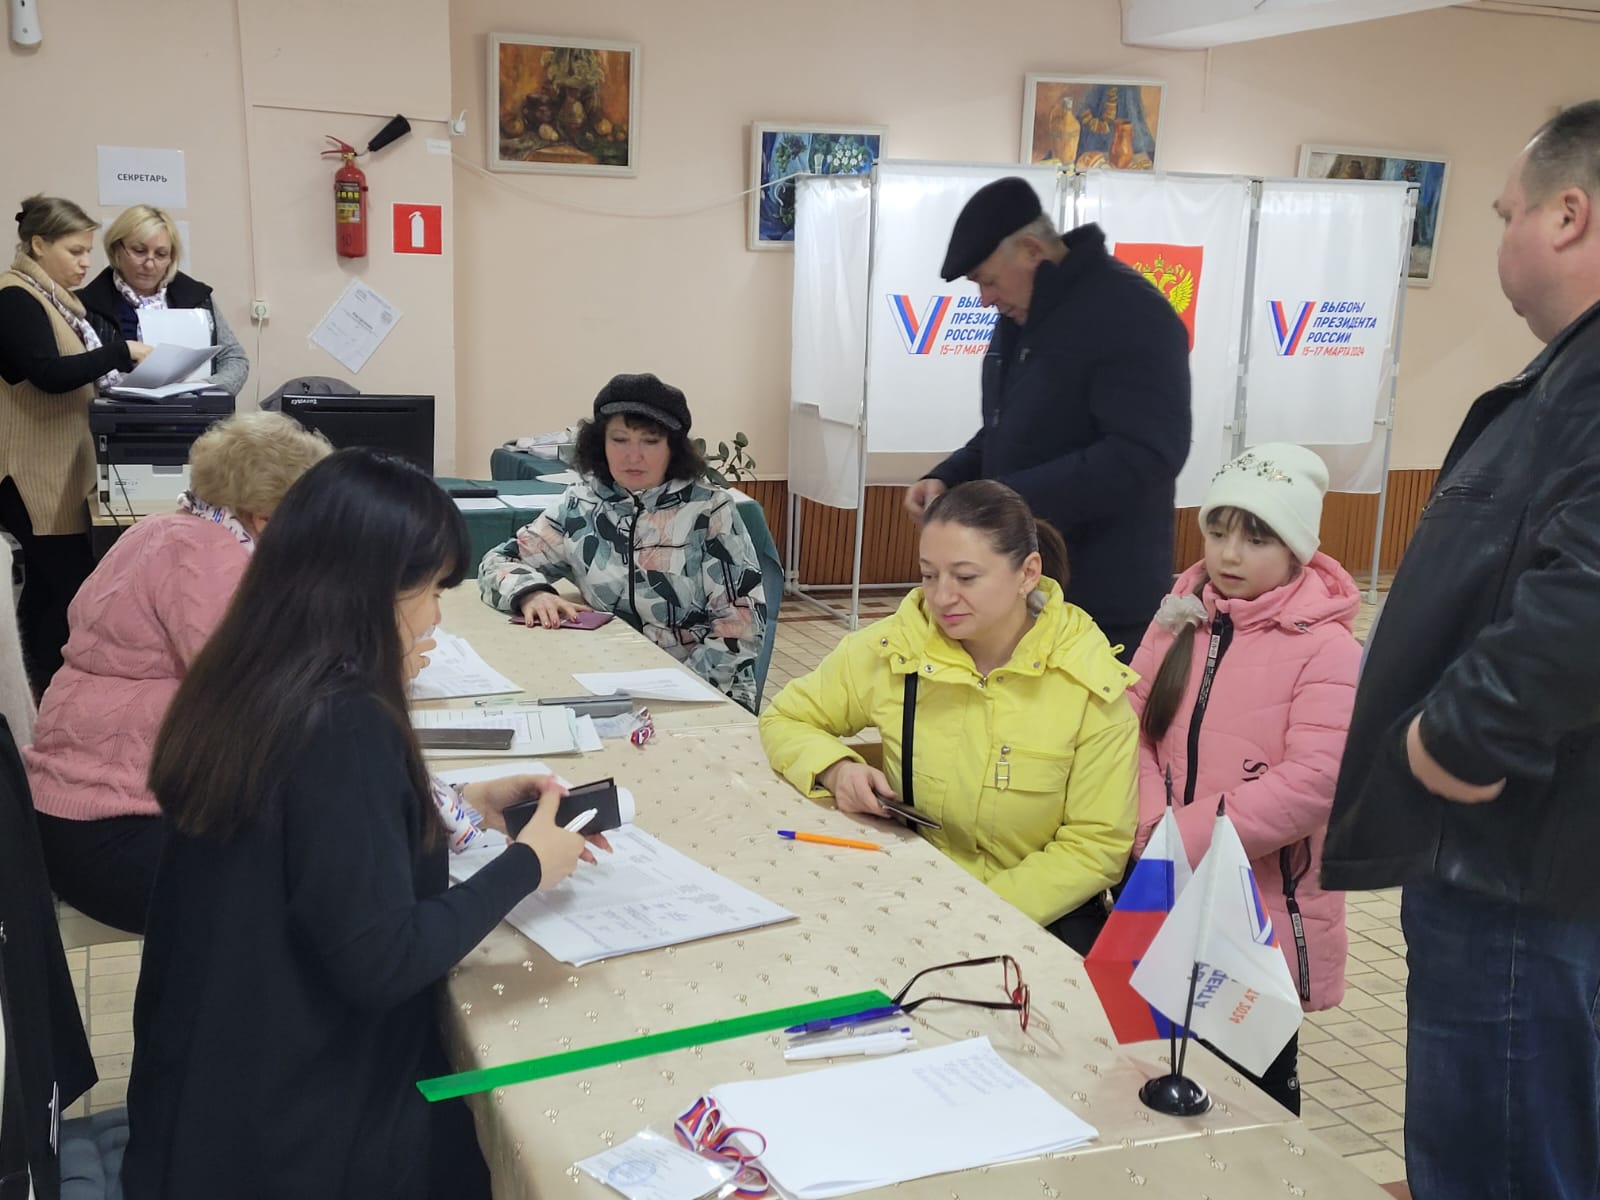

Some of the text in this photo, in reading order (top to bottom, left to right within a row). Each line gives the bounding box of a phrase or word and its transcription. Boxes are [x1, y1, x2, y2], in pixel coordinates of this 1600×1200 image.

[117, 173, 168, 183] СЕКРЕТАРЬ
[1320, 302, 1365, 313] ВЫБОРЫ
[951, 312, 1001, 326] ПРЕЗИД
[1313, 317, 1377, 329] ПРЕЗИДЕНТА
[944, 329, 994, 341] РОССИИ
[1307, 332, 1351, 343] РОССИИ
[963, 345, 989, 355] МАРТ
